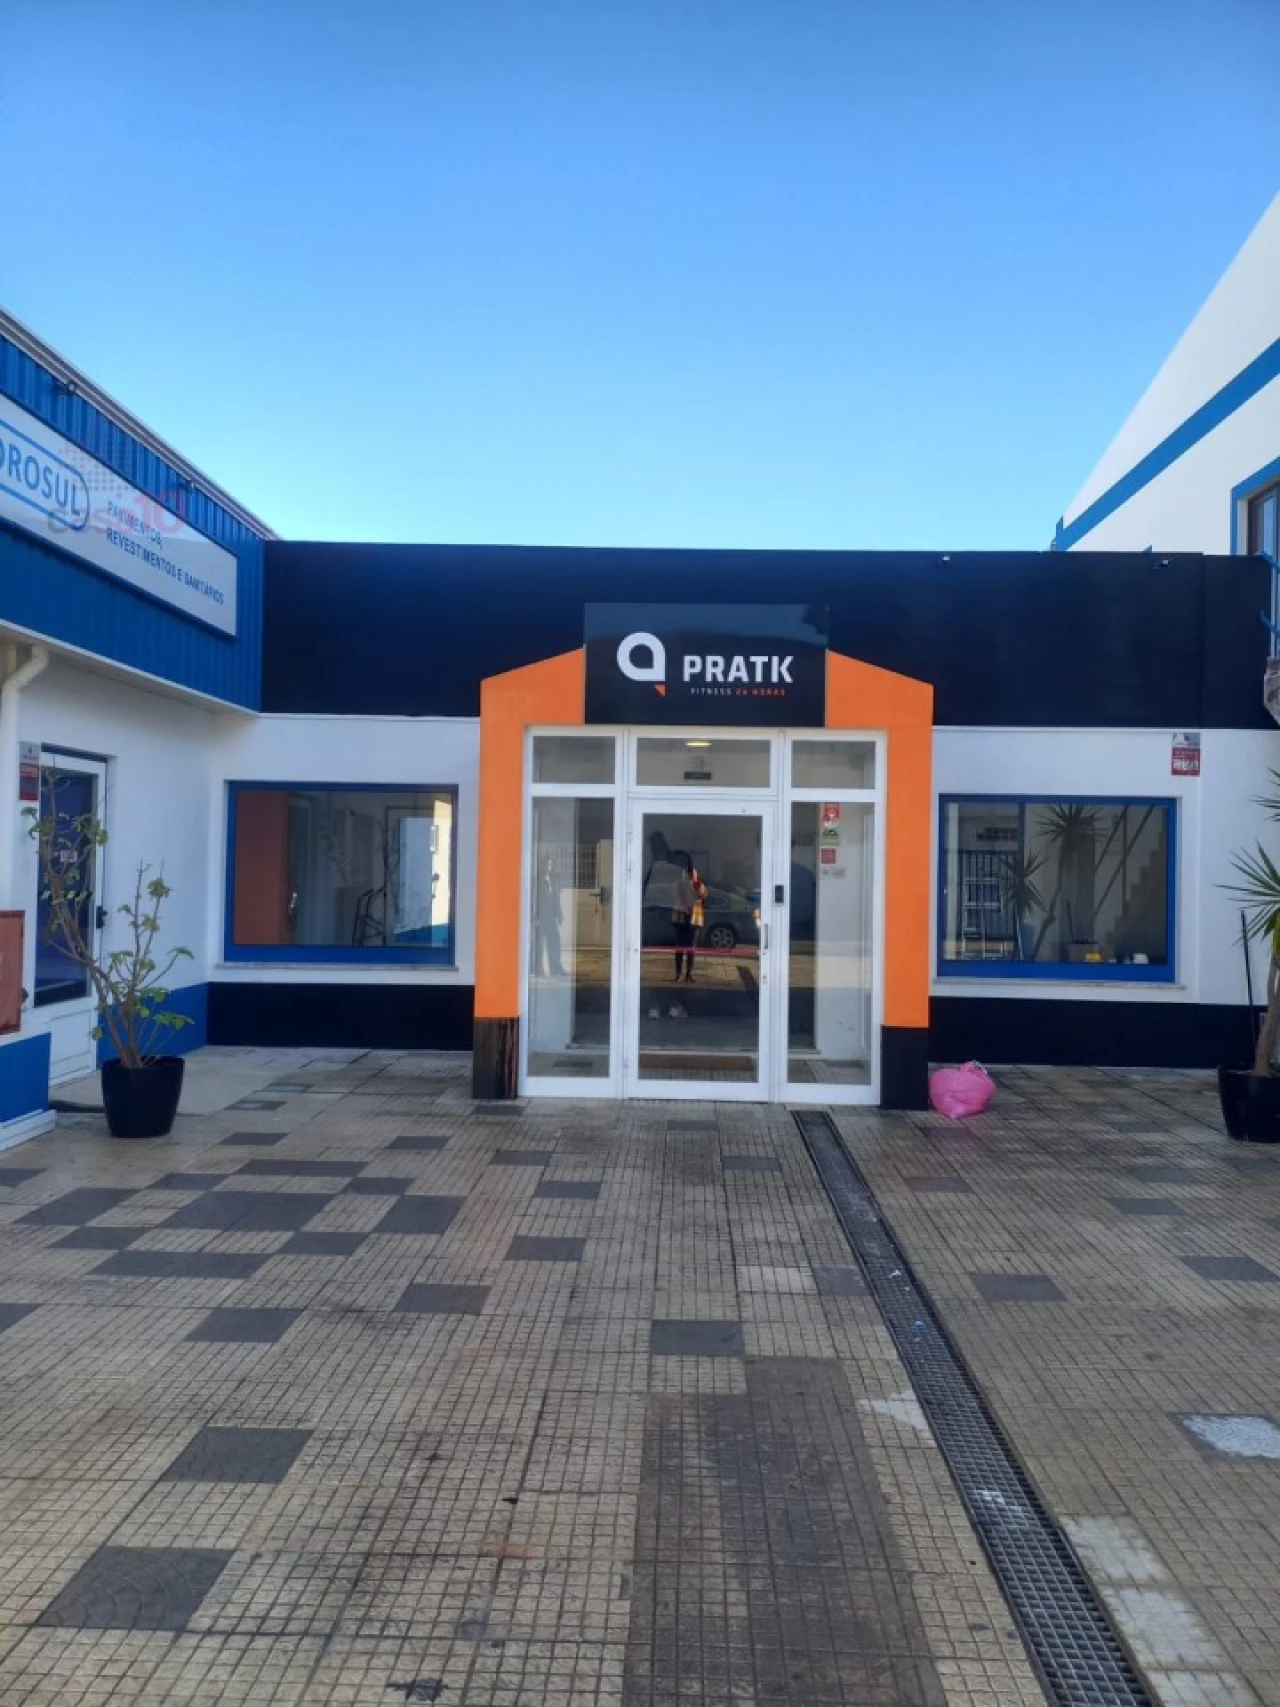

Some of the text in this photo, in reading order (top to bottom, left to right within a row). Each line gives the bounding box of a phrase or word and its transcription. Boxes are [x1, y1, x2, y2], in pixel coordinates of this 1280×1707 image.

[106, 527, 177, 579] REVESTIMENTOS
[177, 568, 183, 582] E
[683, 655, 794, 683] PRATK
[691, 688, 732, 696] FITNESS
[751, 688, 785, 696] HORAS
